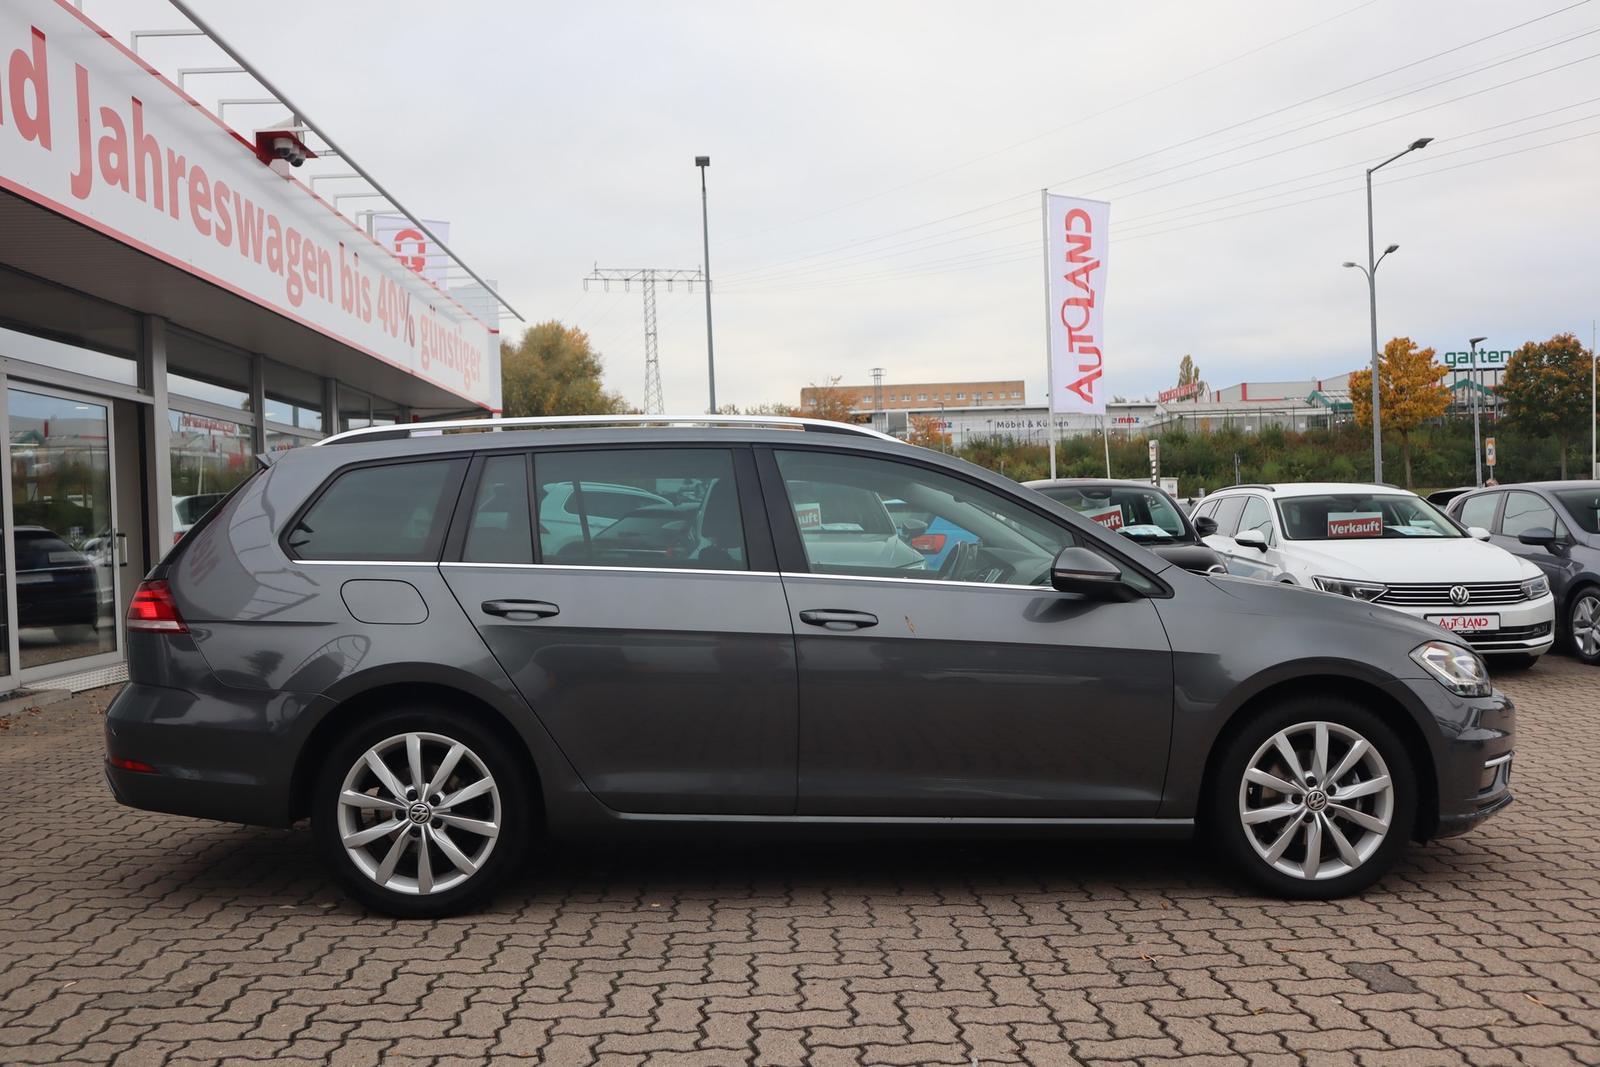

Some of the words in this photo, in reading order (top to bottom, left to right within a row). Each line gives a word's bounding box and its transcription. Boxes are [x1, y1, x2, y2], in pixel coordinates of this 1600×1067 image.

[70, 62, 333, 307] Jahreswagen
[339, 240, 372, 324] bis
[377, 274, 415, 347] 40%
[420, 303, 481, 391] günstiger
[1061, 208, 1103, 405] AUTOLAND
[997, 420, 1025, 429] Möbel
[1028, 420, 1034, 428] &
[1118, 416, 1140, 424] mmz
[1330, 520, 1380, 534] Verkauft
